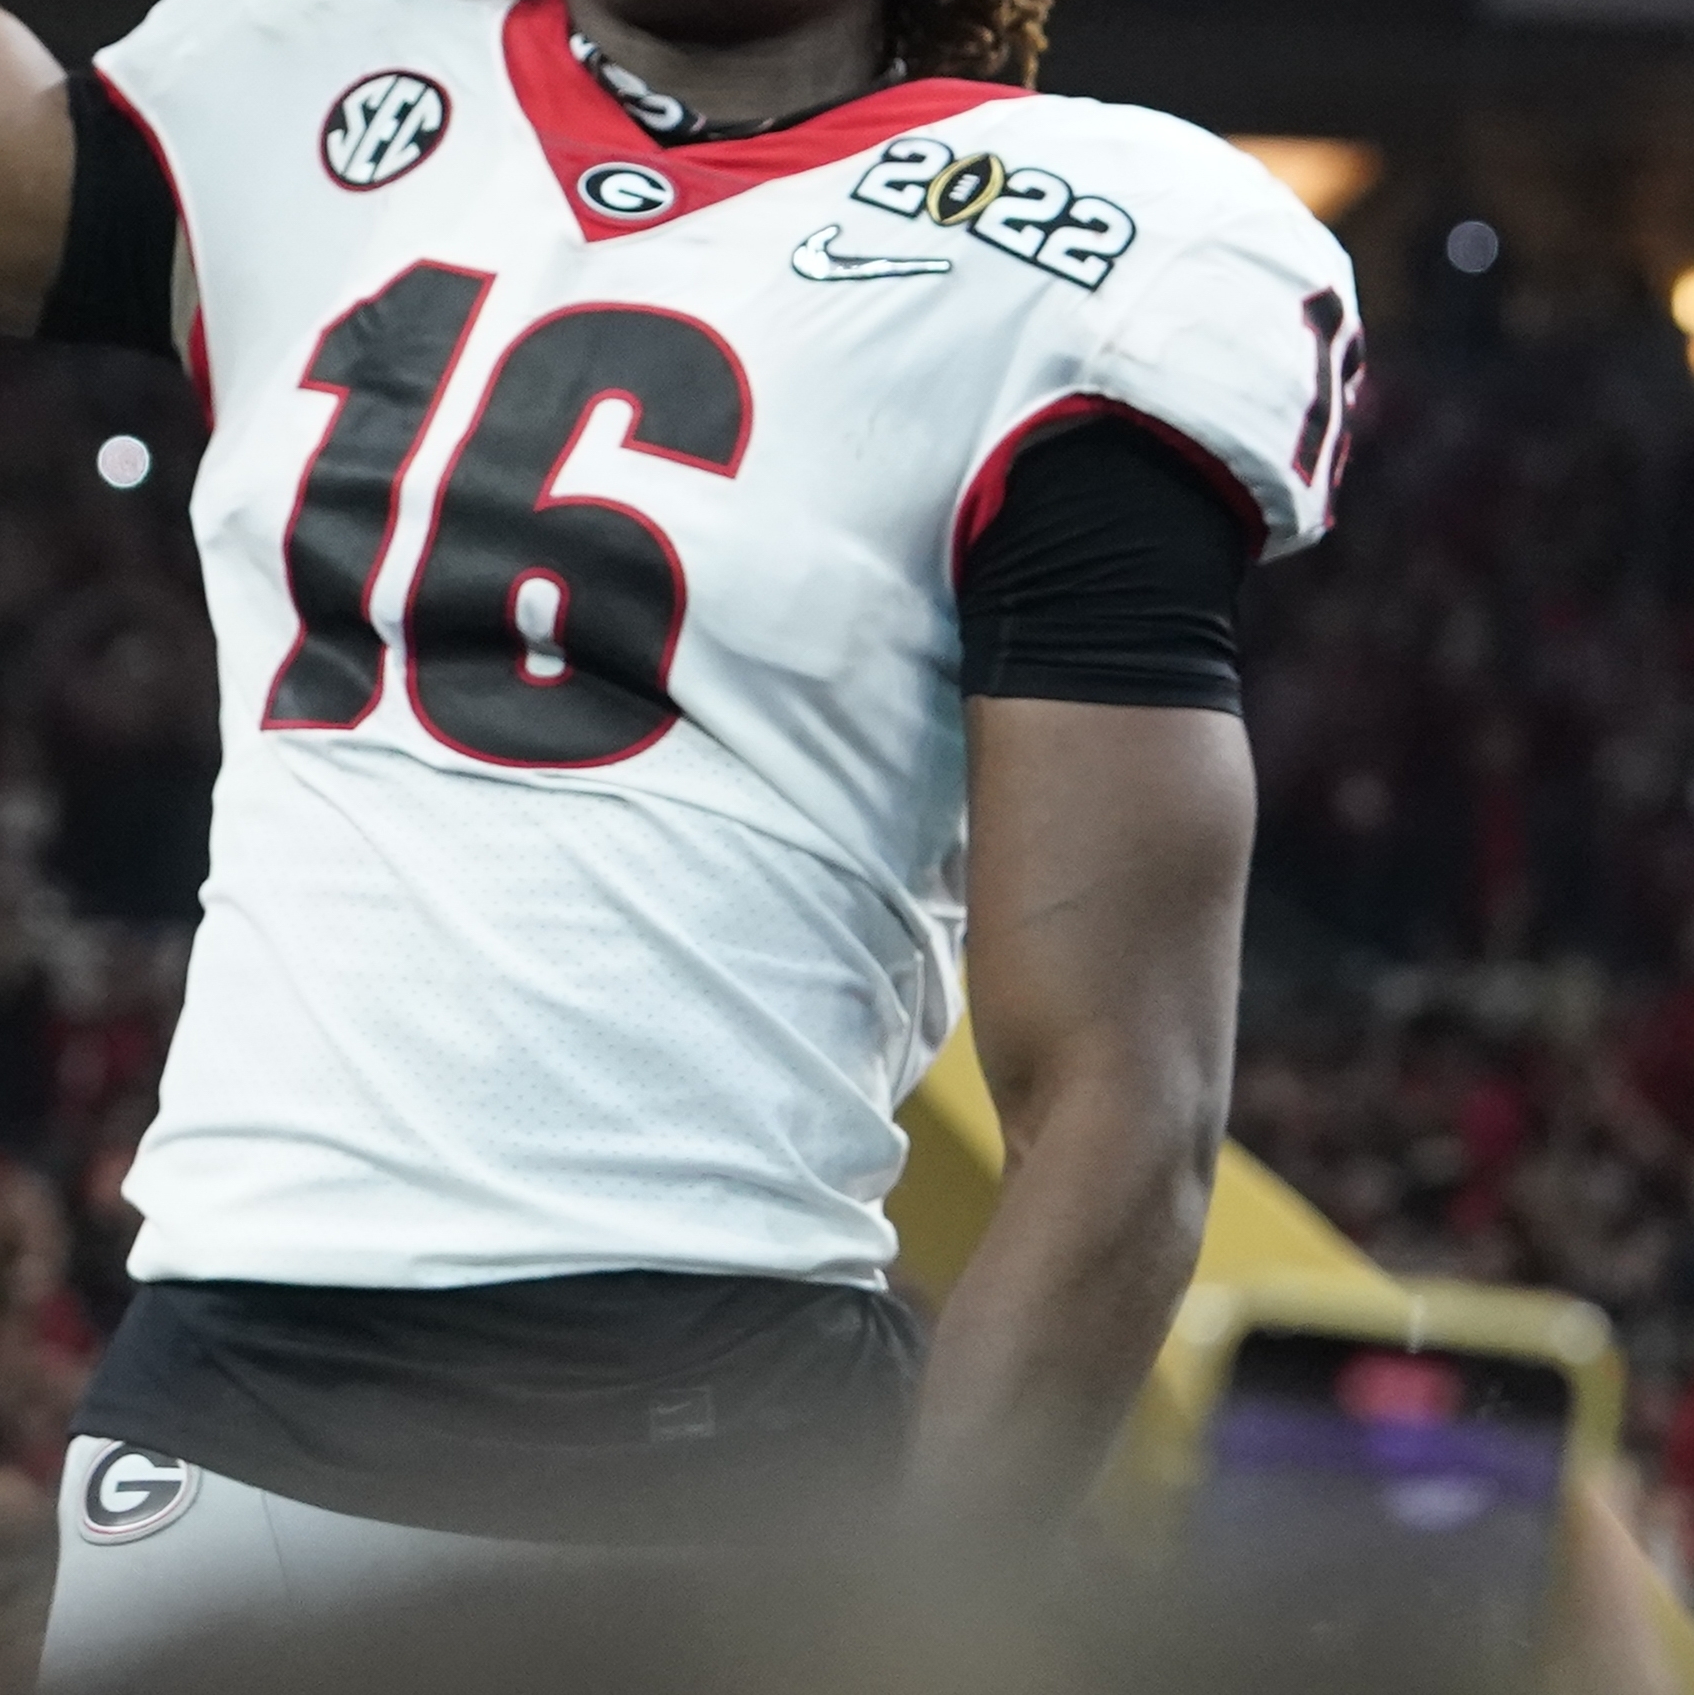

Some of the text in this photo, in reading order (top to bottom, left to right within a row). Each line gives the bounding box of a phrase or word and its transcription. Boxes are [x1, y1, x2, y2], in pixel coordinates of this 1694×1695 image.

[325, 72, 443, 186] SEC
[583, 166, 672, 217] G
[262, 258, 755, 769] 16
